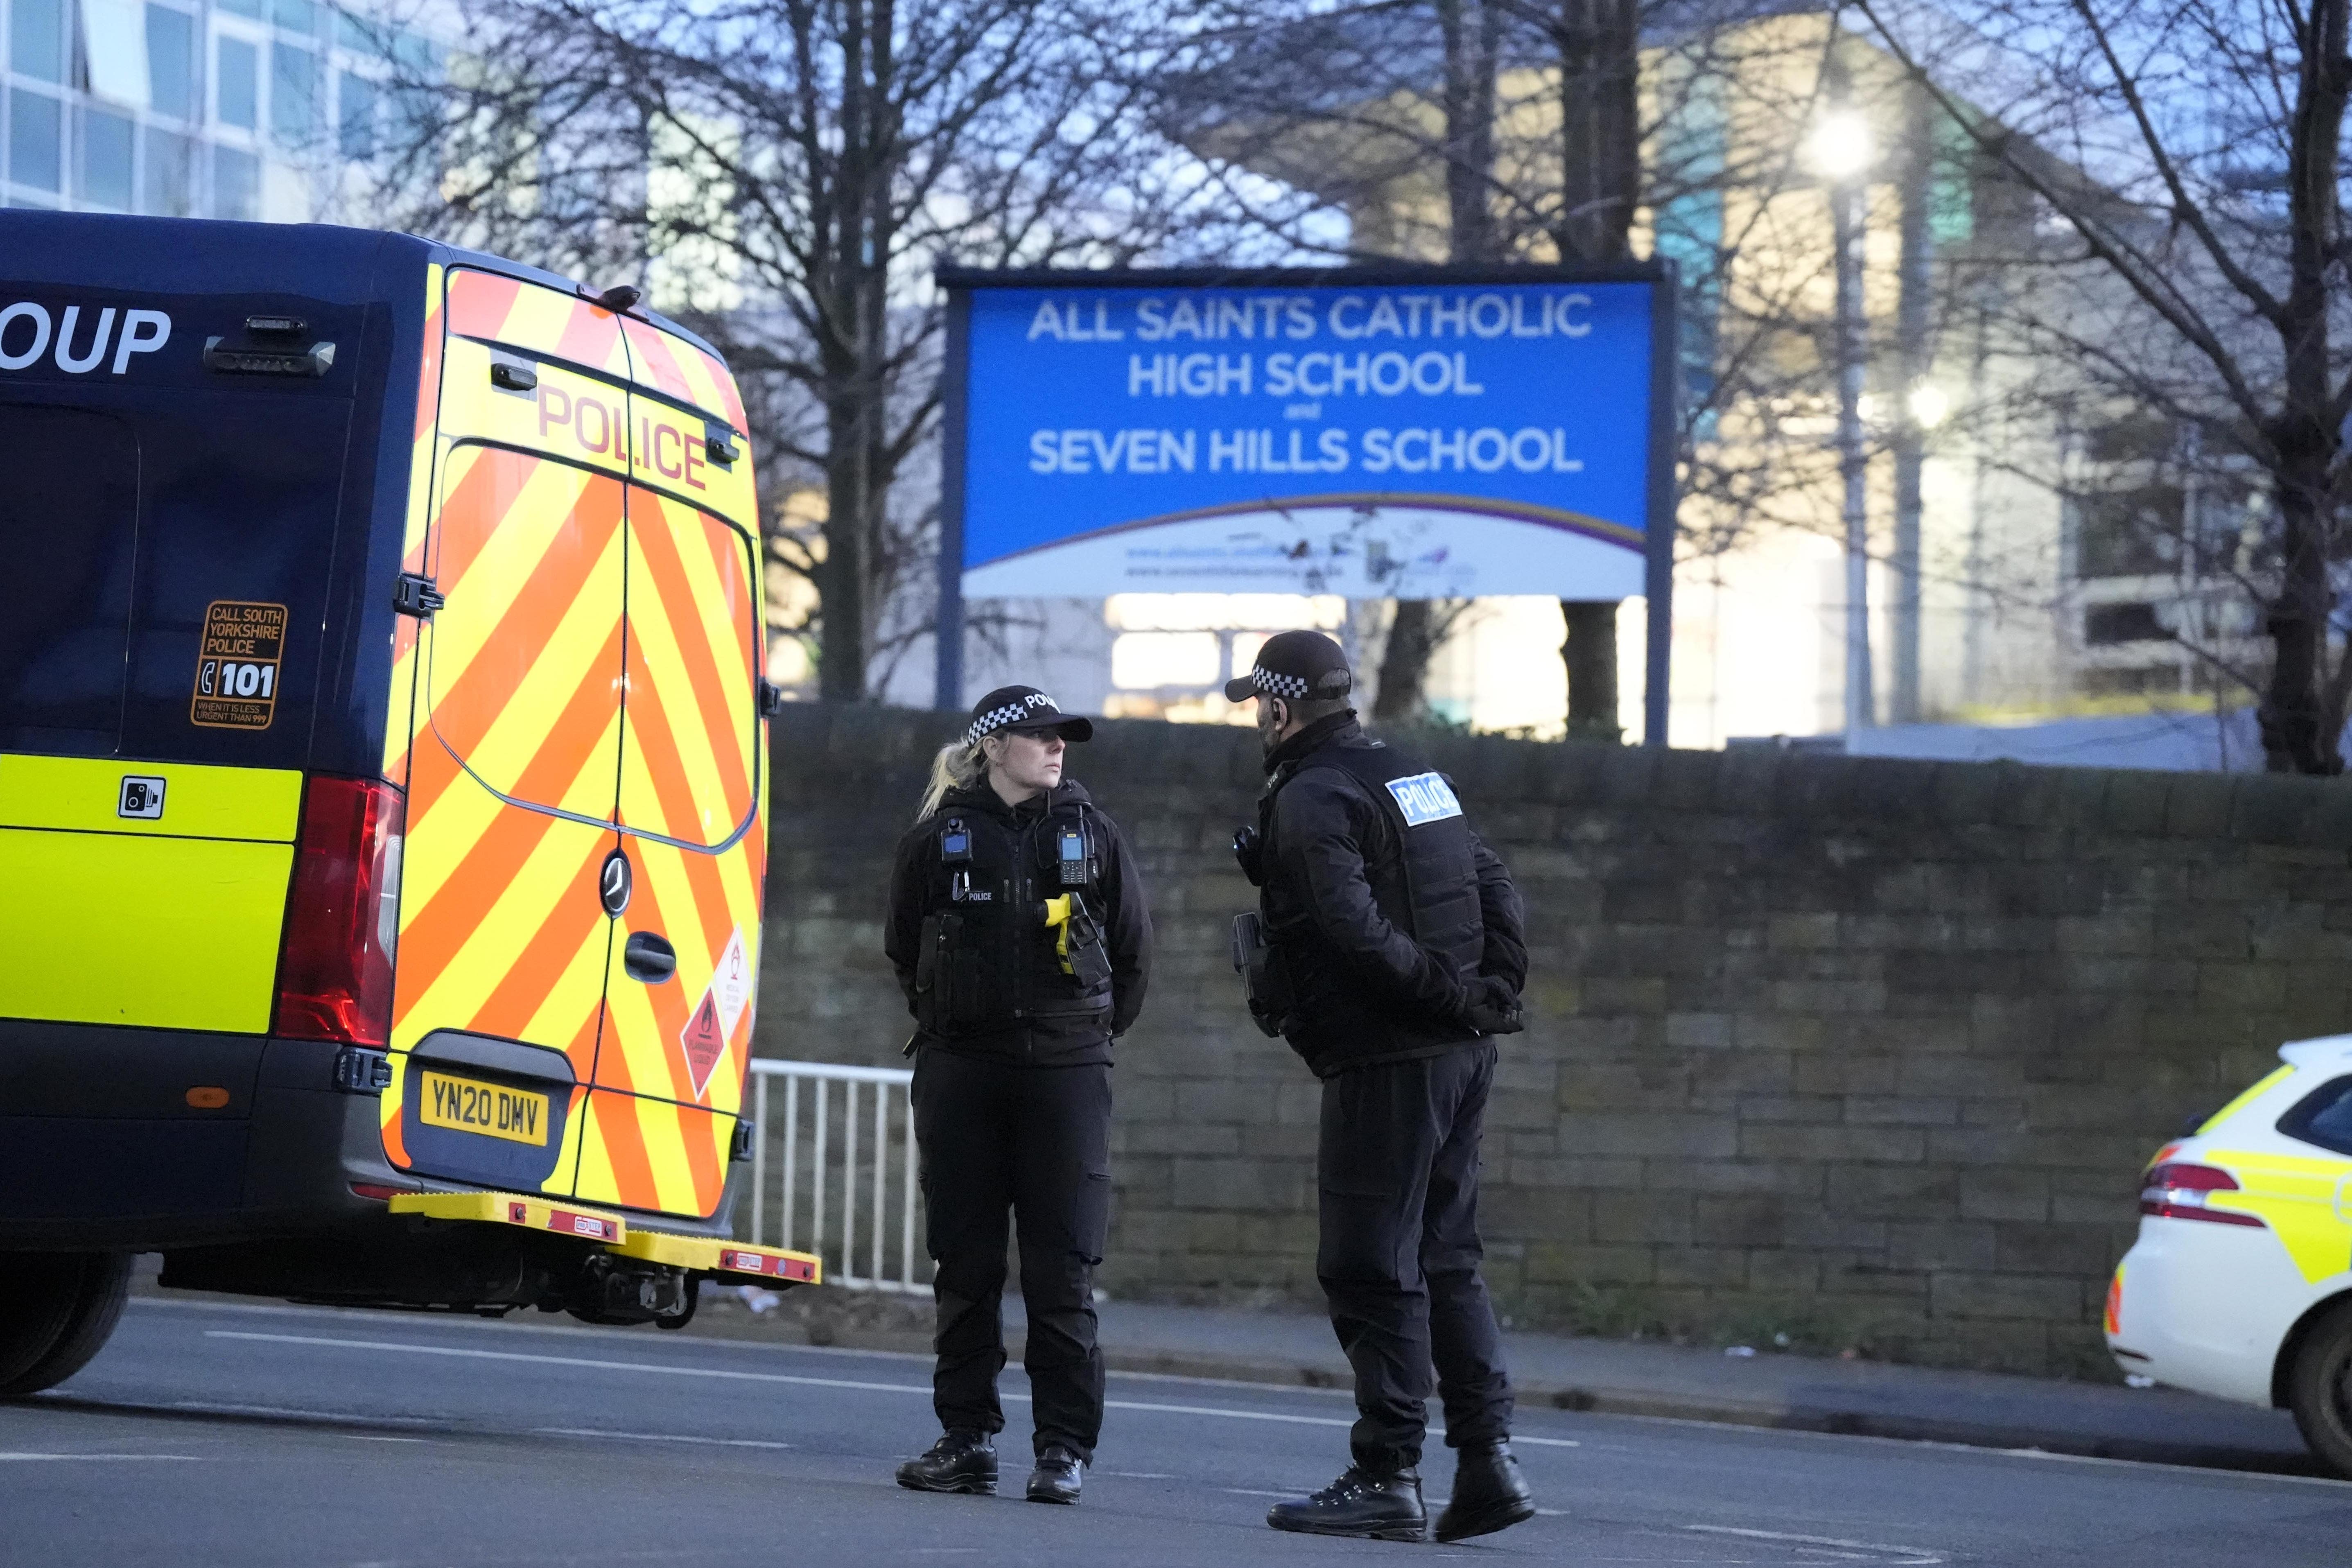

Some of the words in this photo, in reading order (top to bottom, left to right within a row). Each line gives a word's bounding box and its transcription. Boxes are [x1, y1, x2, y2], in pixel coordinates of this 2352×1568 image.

[1027, 299, 1125, 341] ALL
[1136, 297, 1317, 340] SAINTS
[1329, 294, 1593, 339] CATHOLIC
[0, 301, 172, 375] OUP
[1127, 352, 1252, 396] HIGH
[1265, 351, 1484, 396] SCHOOL
[538, 383, 706, 490] POLICE
[1029, 429, 1196, 473] SEVEN
[1209, 429, 1350, 473] HILLS
[1362, 427, 1584, 472] SCHOOL
[210, 622, 280, 639] YORKSHIRE
[212, 608, 241, 621] CALL
[243, 609, 282, 624] SOUTH
[207, 638, 255, 654] POLICE
[222, 663, 274, 697] 101
[197, 711, 228, 721] URGENT
[229, 713, 251, 722] THAN
[253, 715, 267, 723] 999
[198, 701, 221, 712] WHEN
[231, 704, 239, 712] IS
[240, 705, 260, 714] LESS
[1396, 780, 1457, 817] POLICE
[969, 892, 992, 901] POLICE
[433, 1080, 491, 1126] YN20
[498, 1092, 538, 1135] DMV
